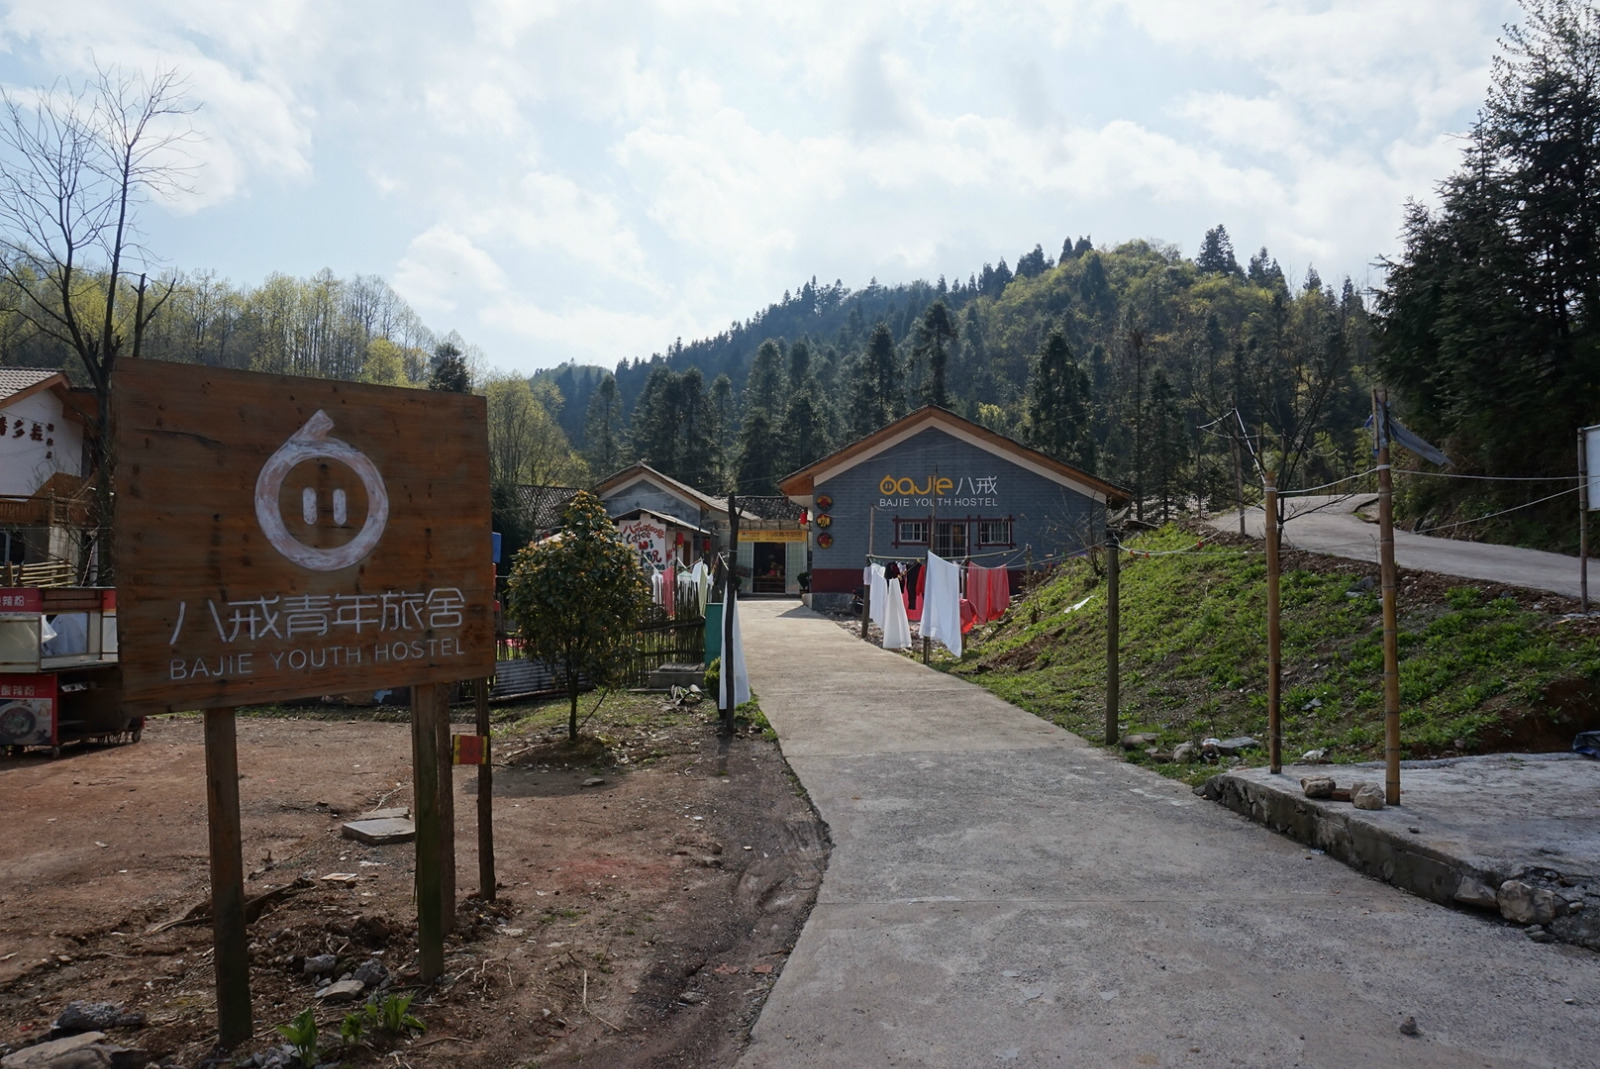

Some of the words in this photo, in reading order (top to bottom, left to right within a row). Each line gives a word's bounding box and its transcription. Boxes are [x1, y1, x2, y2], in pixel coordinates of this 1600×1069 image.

[955, 476, 998, 495] 八戒
[879, 498, 910, 507] BAJIE
[914, 498, 952, 507] YOUTH
[955, 498, 998, 507] HOSTEL
[0, 595, 25, 607] 辣粉
[169, 588, 465, 645] 八戒青年旅舍
[170, 653, 253, 680] BAJIE
[270, 646, 362, 671] YOUTH
[374, 637, 466, 662] HOSTEL
